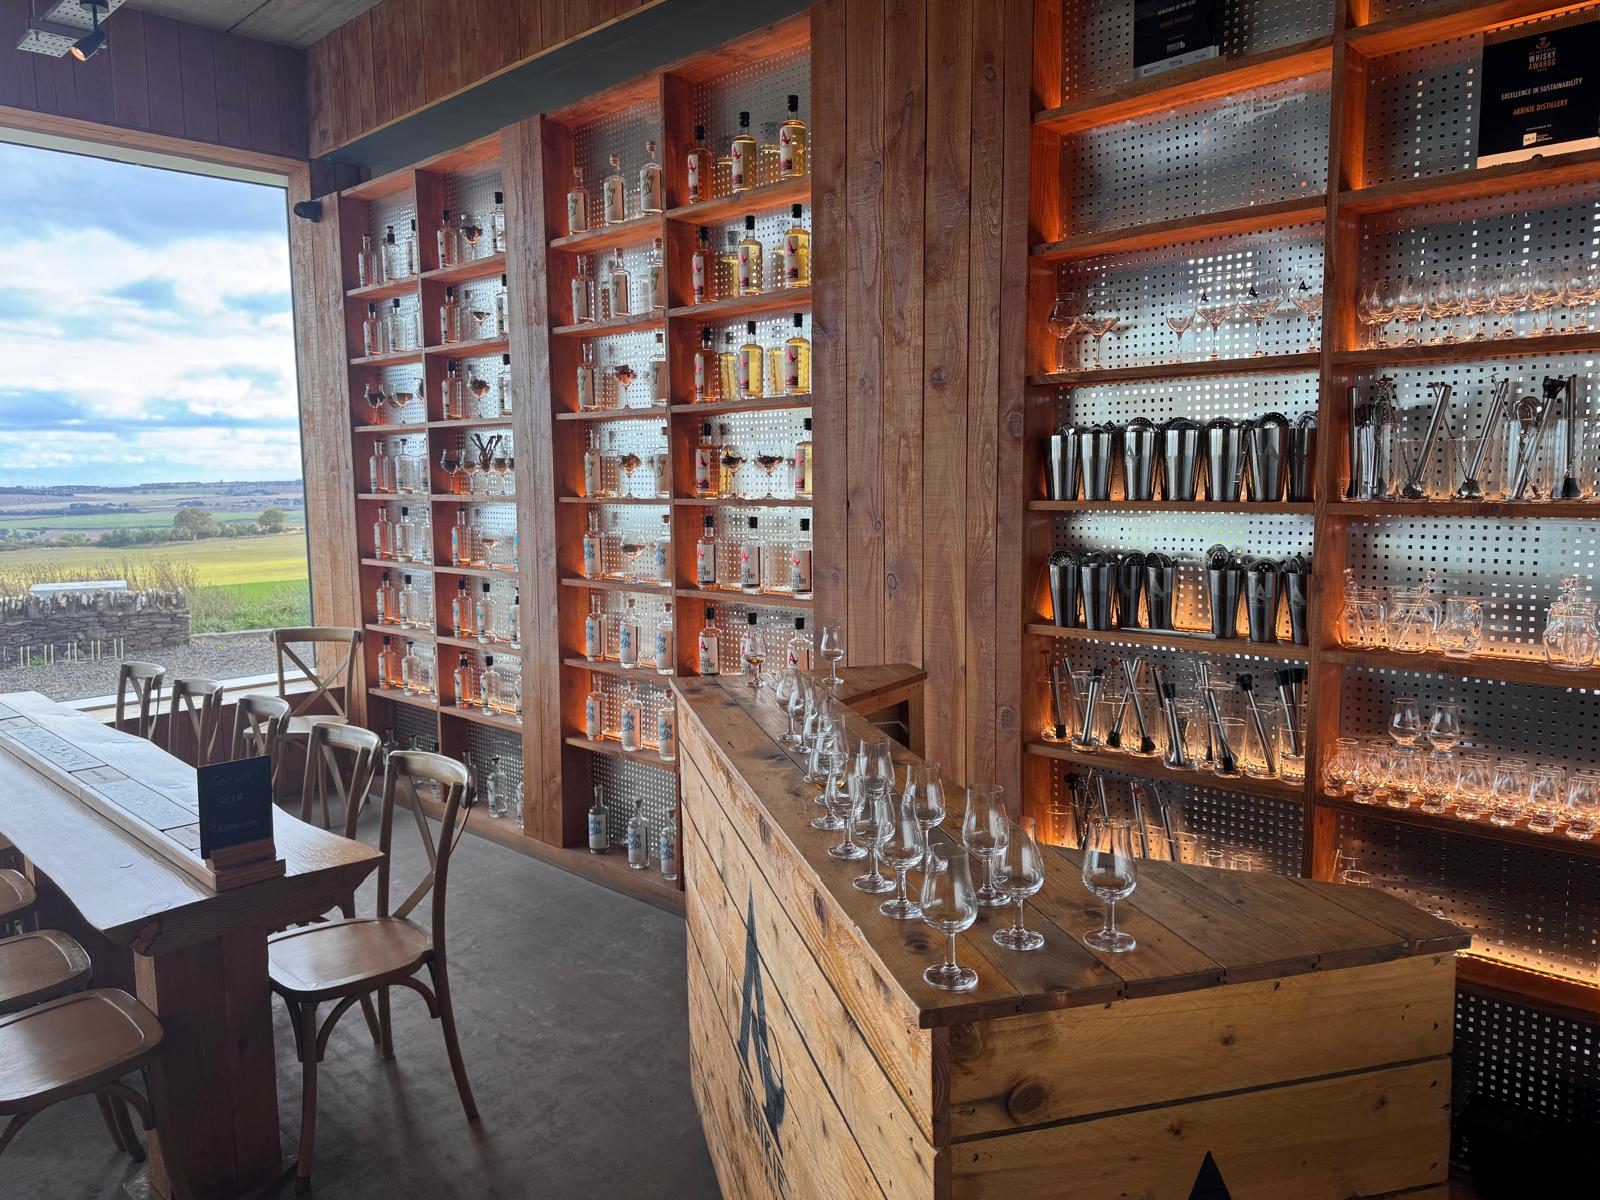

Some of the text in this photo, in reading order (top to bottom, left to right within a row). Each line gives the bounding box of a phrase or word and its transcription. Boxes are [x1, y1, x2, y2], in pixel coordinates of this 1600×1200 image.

[1528, 50, 1556, 63] WHISKY
[1528, 58, 1556, 71] AWARDS
[1501, 88, 1531, 101] EXCELLENCE
[1540, 77, 1583, 93] SUSTAINABILITY
[1536, 99, 1568, 111] DISTILLERY
